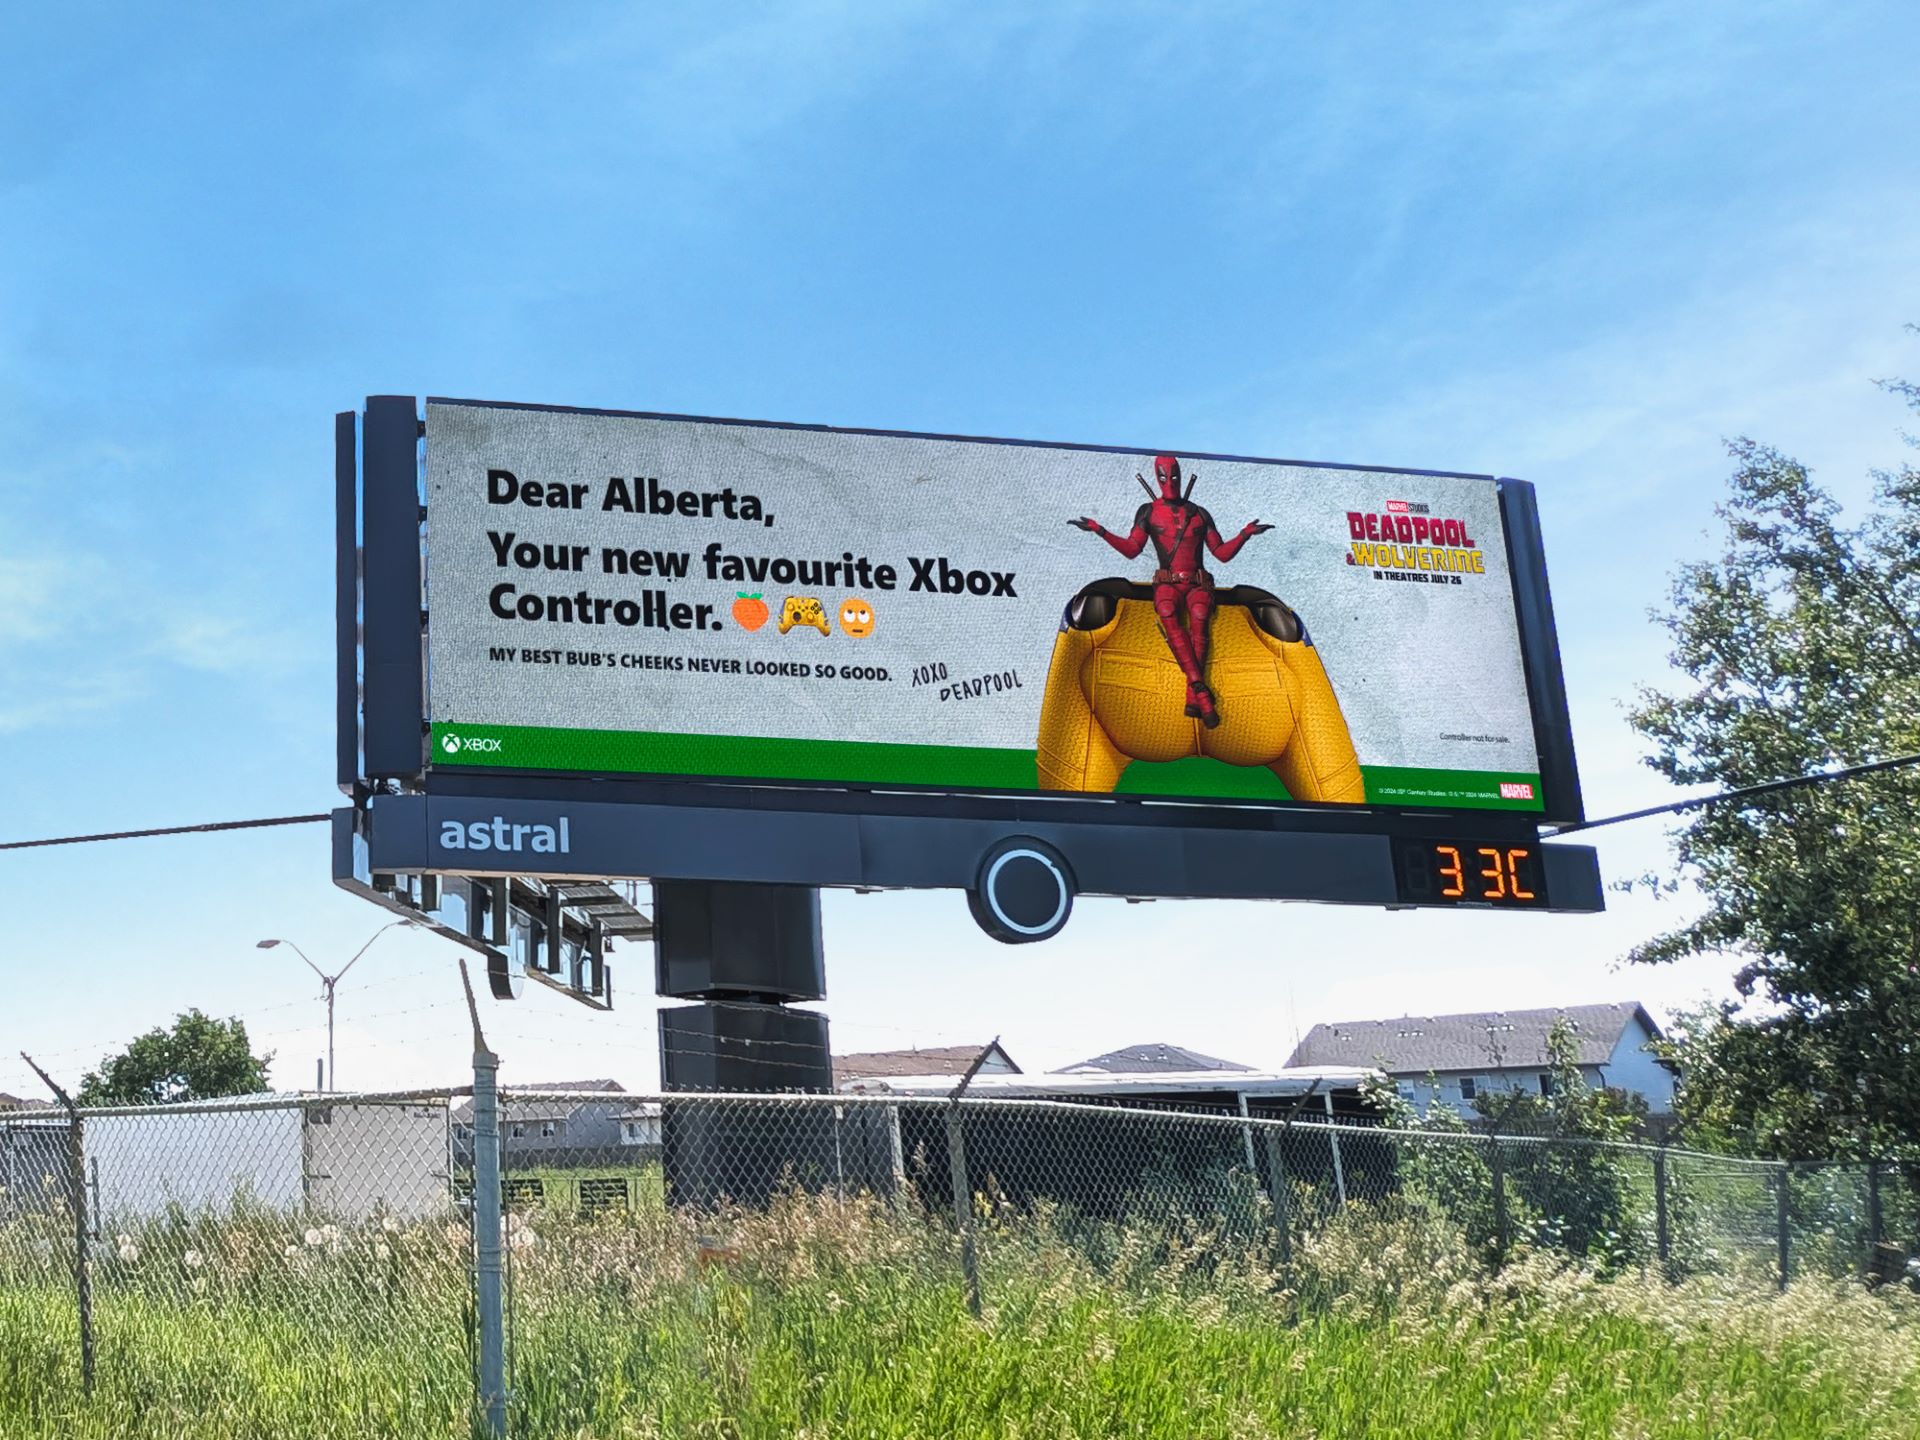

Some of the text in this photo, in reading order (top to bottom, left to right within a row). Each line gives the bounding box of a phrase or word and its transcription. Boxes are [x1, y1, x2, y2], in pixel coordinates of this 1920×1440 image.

[487, 469, 775, 527] Dear Alberta,
[1347, 512, 1475, 548] DEADPOOL
[487, 531, 1018, 597] Your new favourite Xbox
[1351, 542, 1485, 574] WOLVERINE
[1373, 570, 1462, 585] IN THEATRES JULY 26
[489, 583, 723, 631] Controller.
[489, 648, 893, 682] MY BEST BUB'S CHEEKS NEVER LOOKED SO GOOD.
[911, 662, 948, 688] XOXO
[940, 669, 1023, 702] DEADPOOL
[463, 738, 502, 752] XBOX
[1440, 732, 1471, 742] Controller
[1500, 783, 1534, 799] MARVEL
[440, 816, 570, 853] astral
